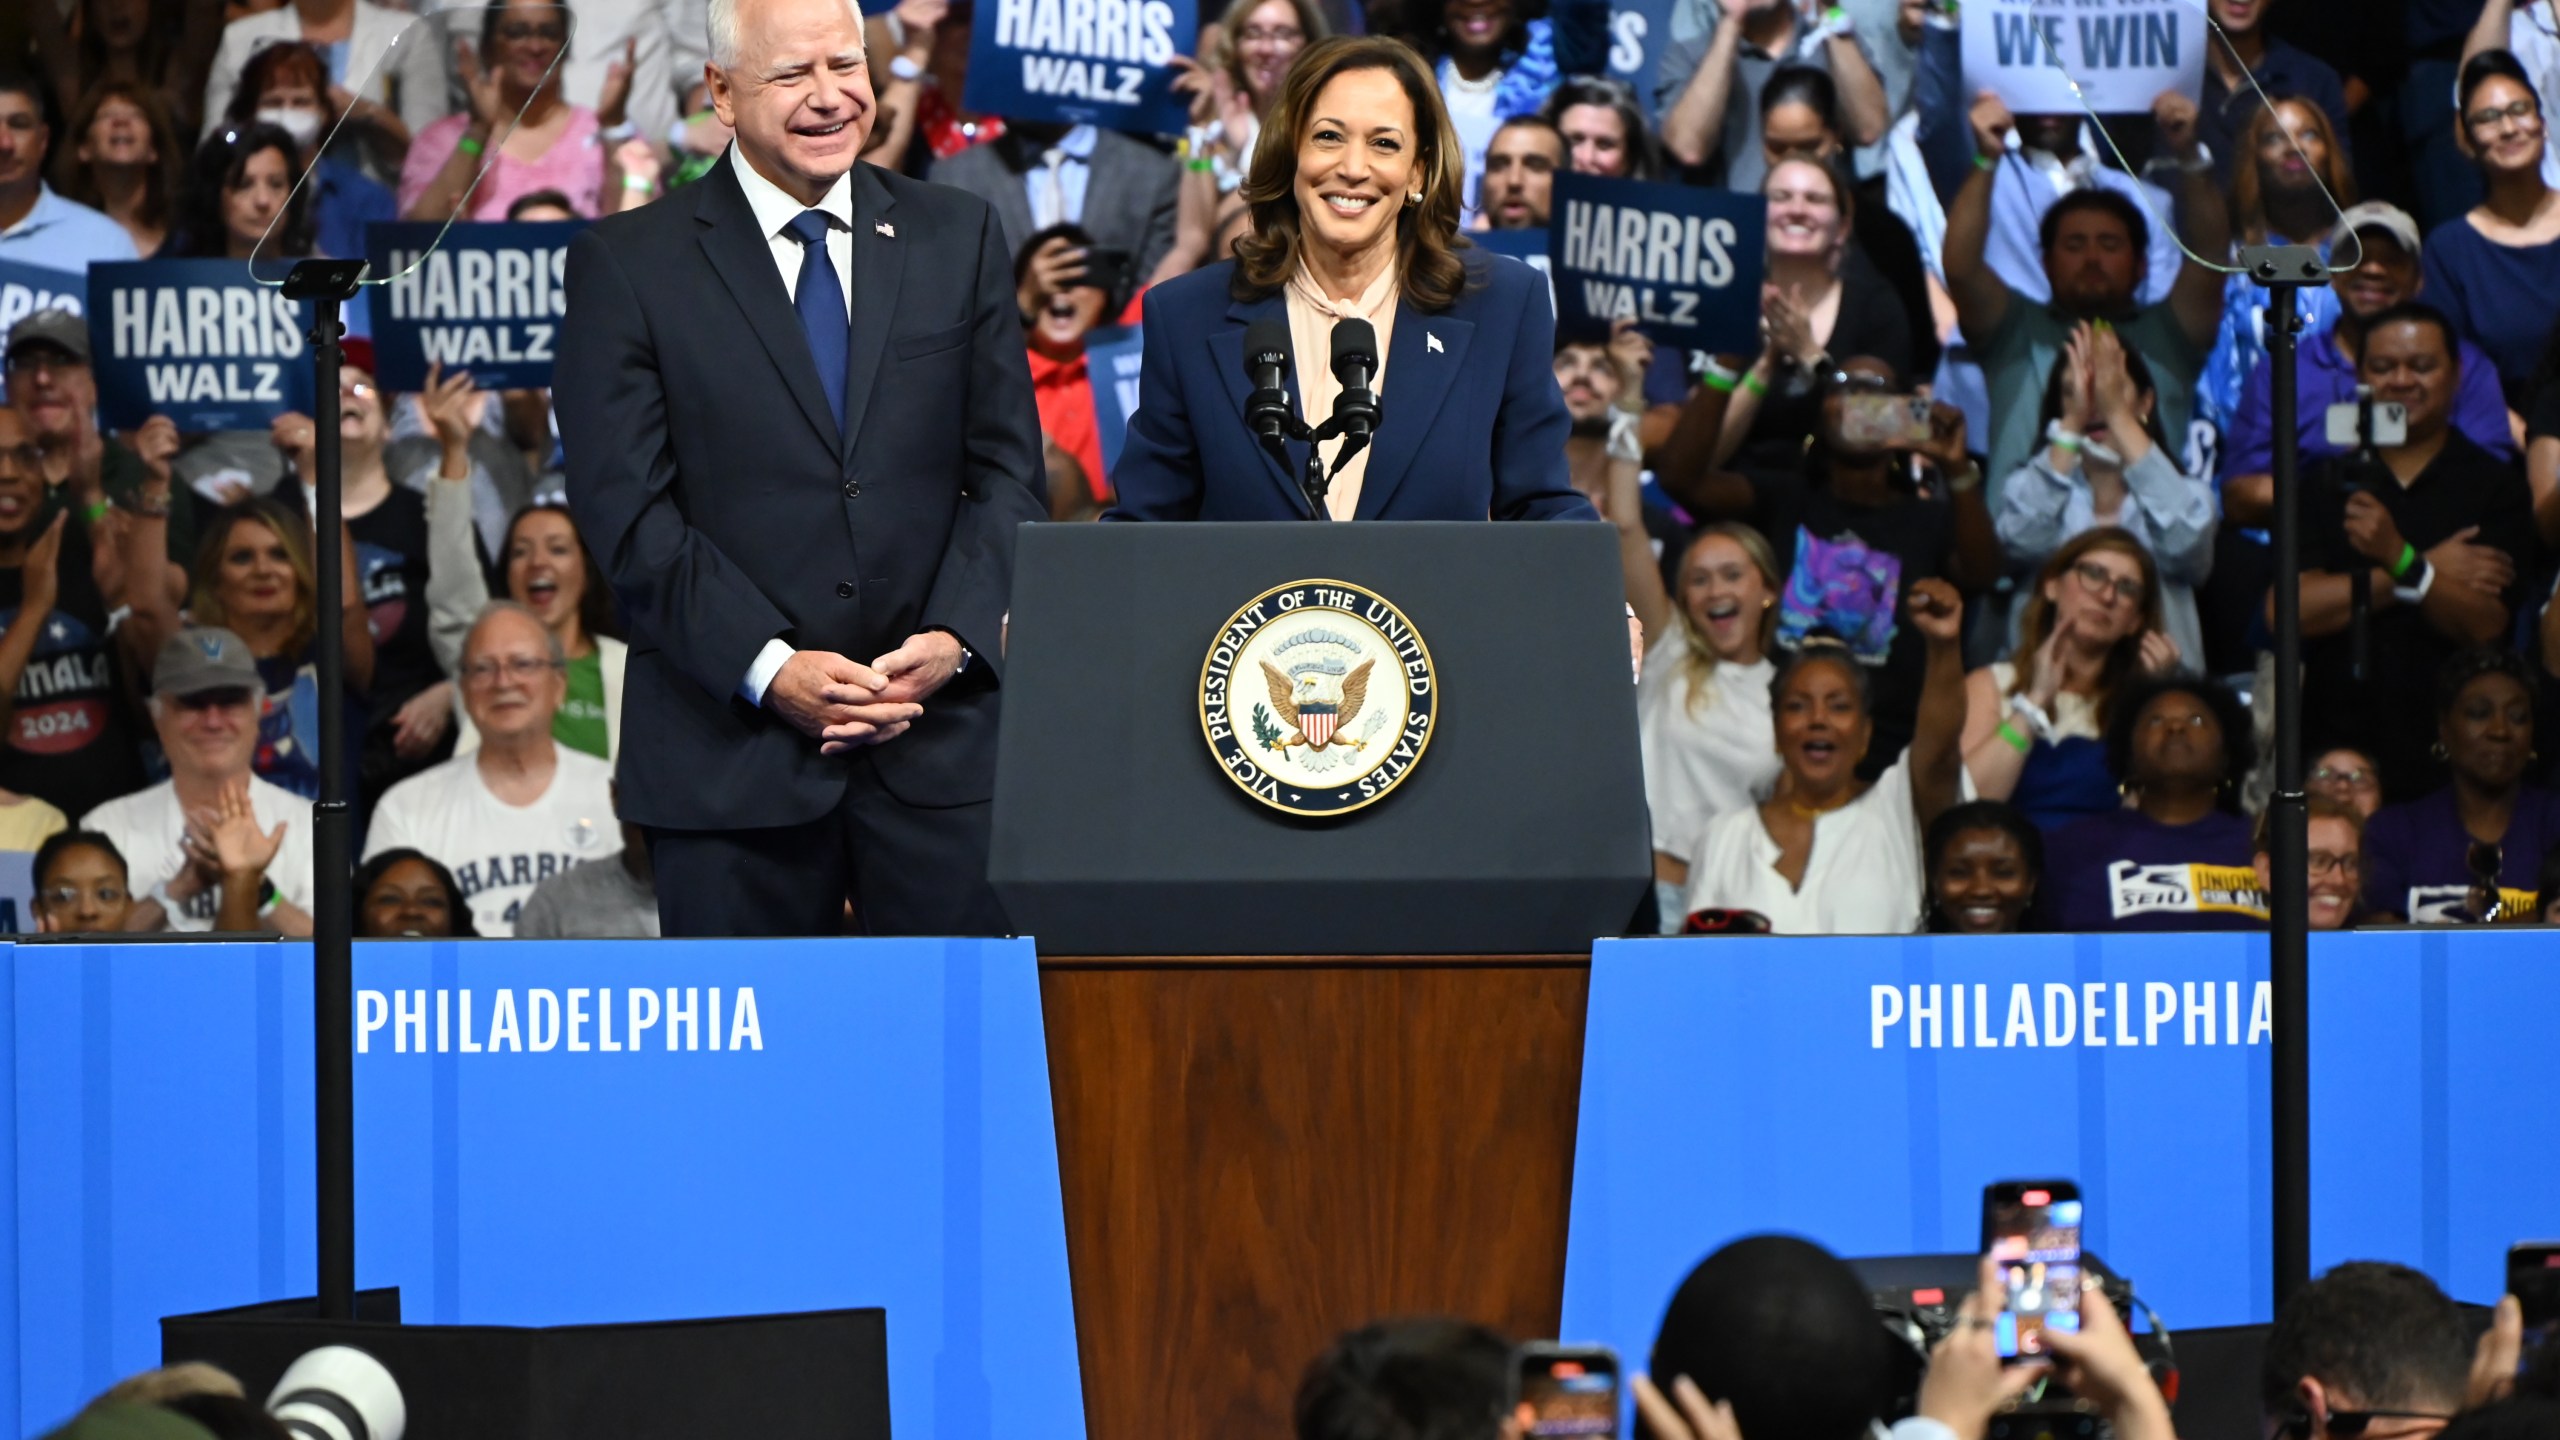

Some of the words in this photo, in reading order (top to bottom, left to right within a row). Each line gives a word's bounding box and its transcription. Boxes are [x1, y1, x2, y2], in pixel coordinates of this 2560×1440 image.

[995, 0, 1175, 67] HARRIS
[1993, 12, 2064, 67] WE
[2077, 11, 2178, 69] WIN
[1022, 54, 1145, 105] WALZ
[1564, 199, 1737, 289] HARRIS
[112, 286, 304, 360] HARRIS
[1583, 279, 1700, 326] WALZ
[419, 323, 554, 365] WALZ
[145, 363, 282, 403] WALZ
[1278, 590, 1305, 611] OF
[1314, 589, 1356, 611] THE
[1205, 602, 1270, 742] PRESIDENT
[1365, 600, 1430, 695] UNITED
[21, 708, 90, 739] 2024
[1225, 749, 1279, 803] VICE
[1358, 712, 1429, 798] STATES
[456, 853, 584, 898] HARRI
[2120, 889, 2188, 909] SEIU
[357, 987, 764, 1053] PHILADELPHIA
[1871, 981, 2272, 1048] PHILADELPHIA
